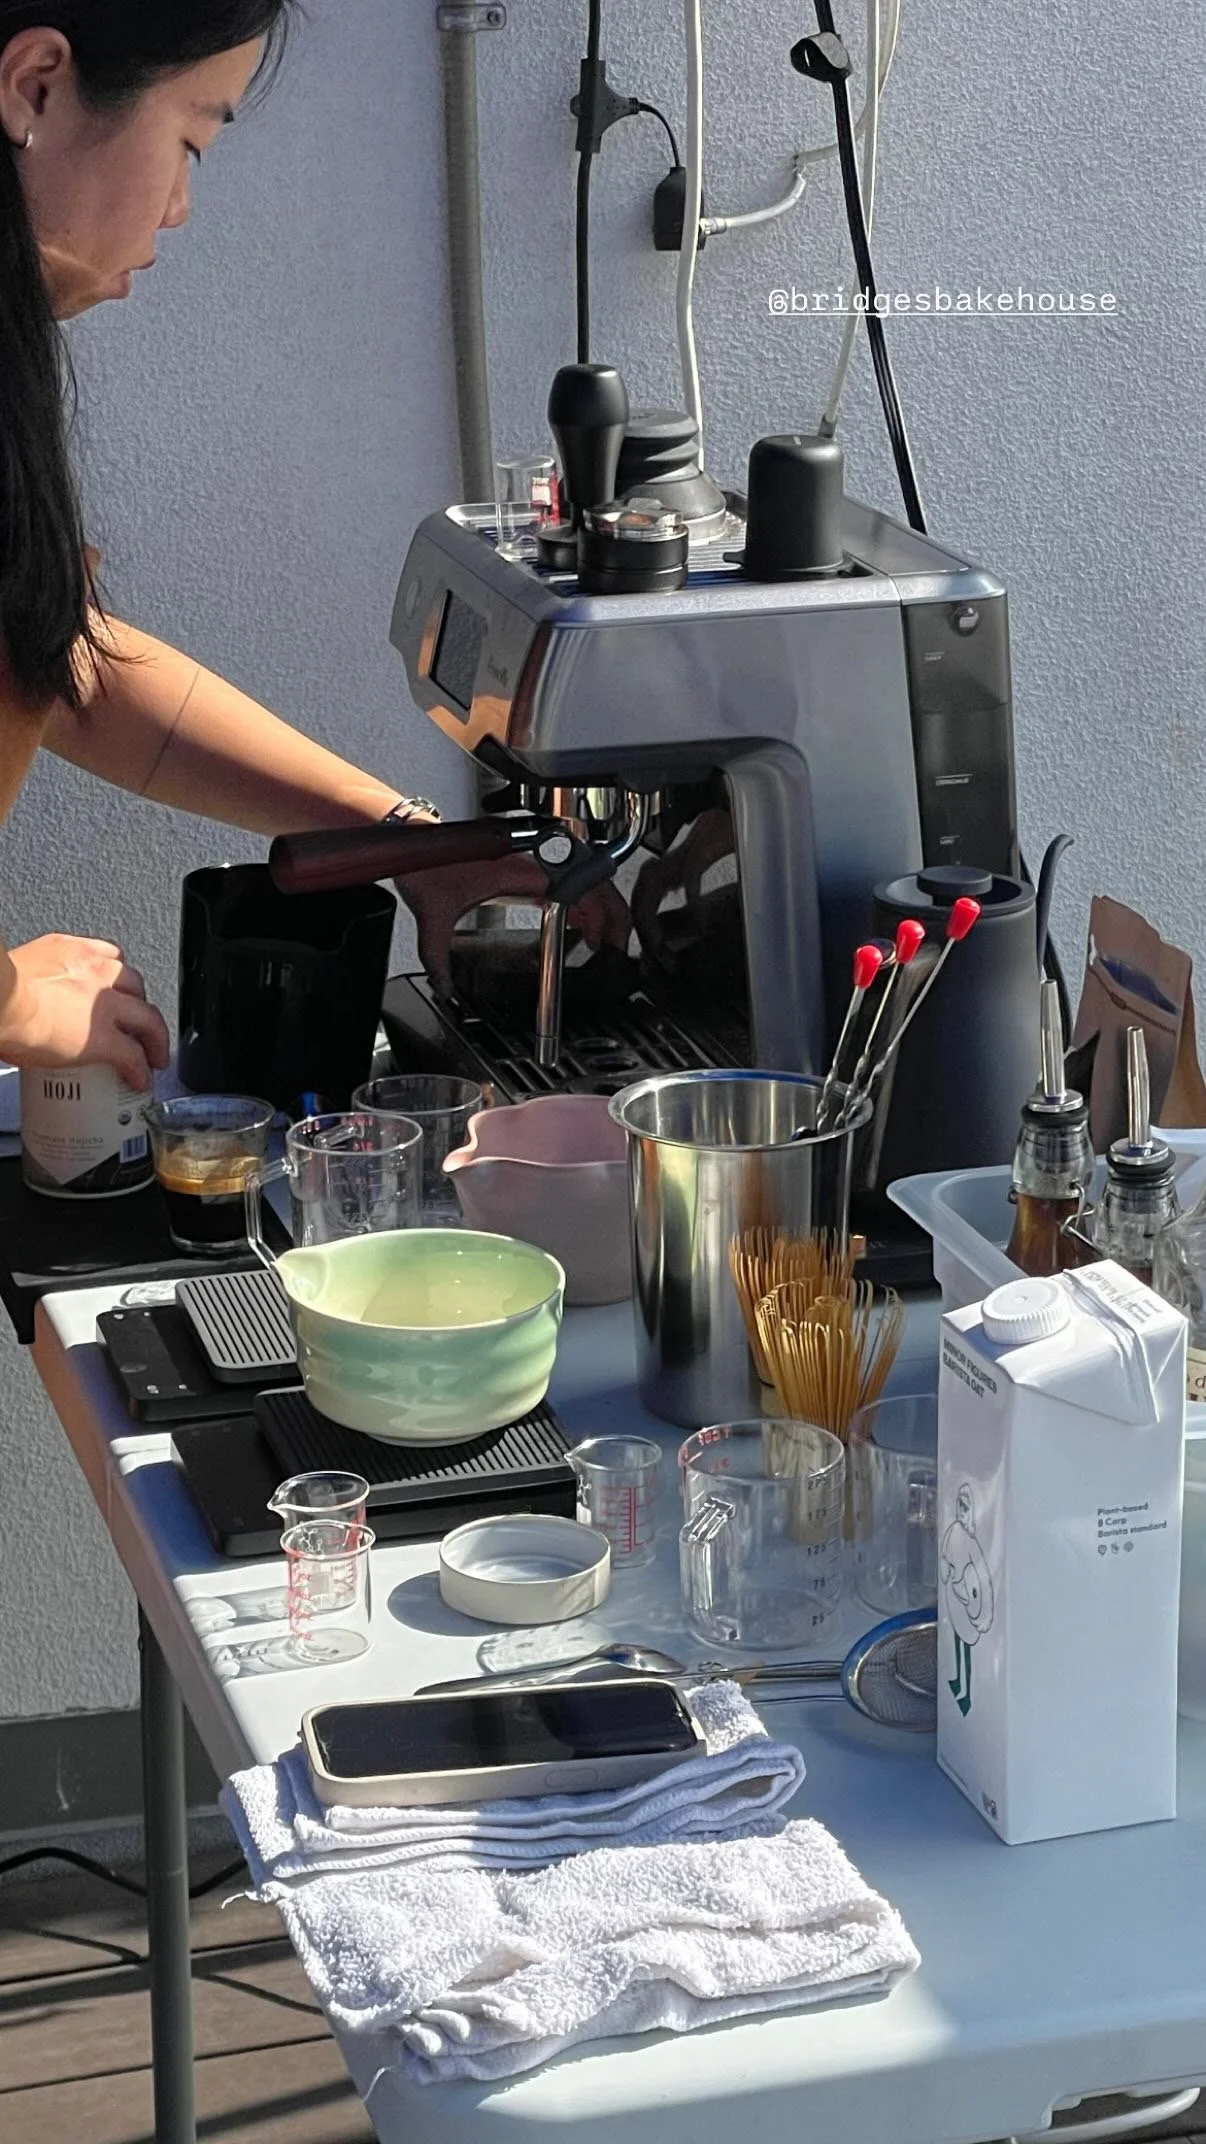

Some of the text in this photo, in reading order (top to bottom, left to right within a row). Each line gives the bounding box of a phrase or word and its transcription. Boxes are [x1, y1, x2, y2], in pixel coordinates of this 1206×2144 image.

[43, 1079, 81, 1101] HOJI
[970, 1378, 985, 1398] OAT
[1097, 1501, 1149, 1516] Plant-based
[1097, 1520, 1167, 1538] Barista standard
